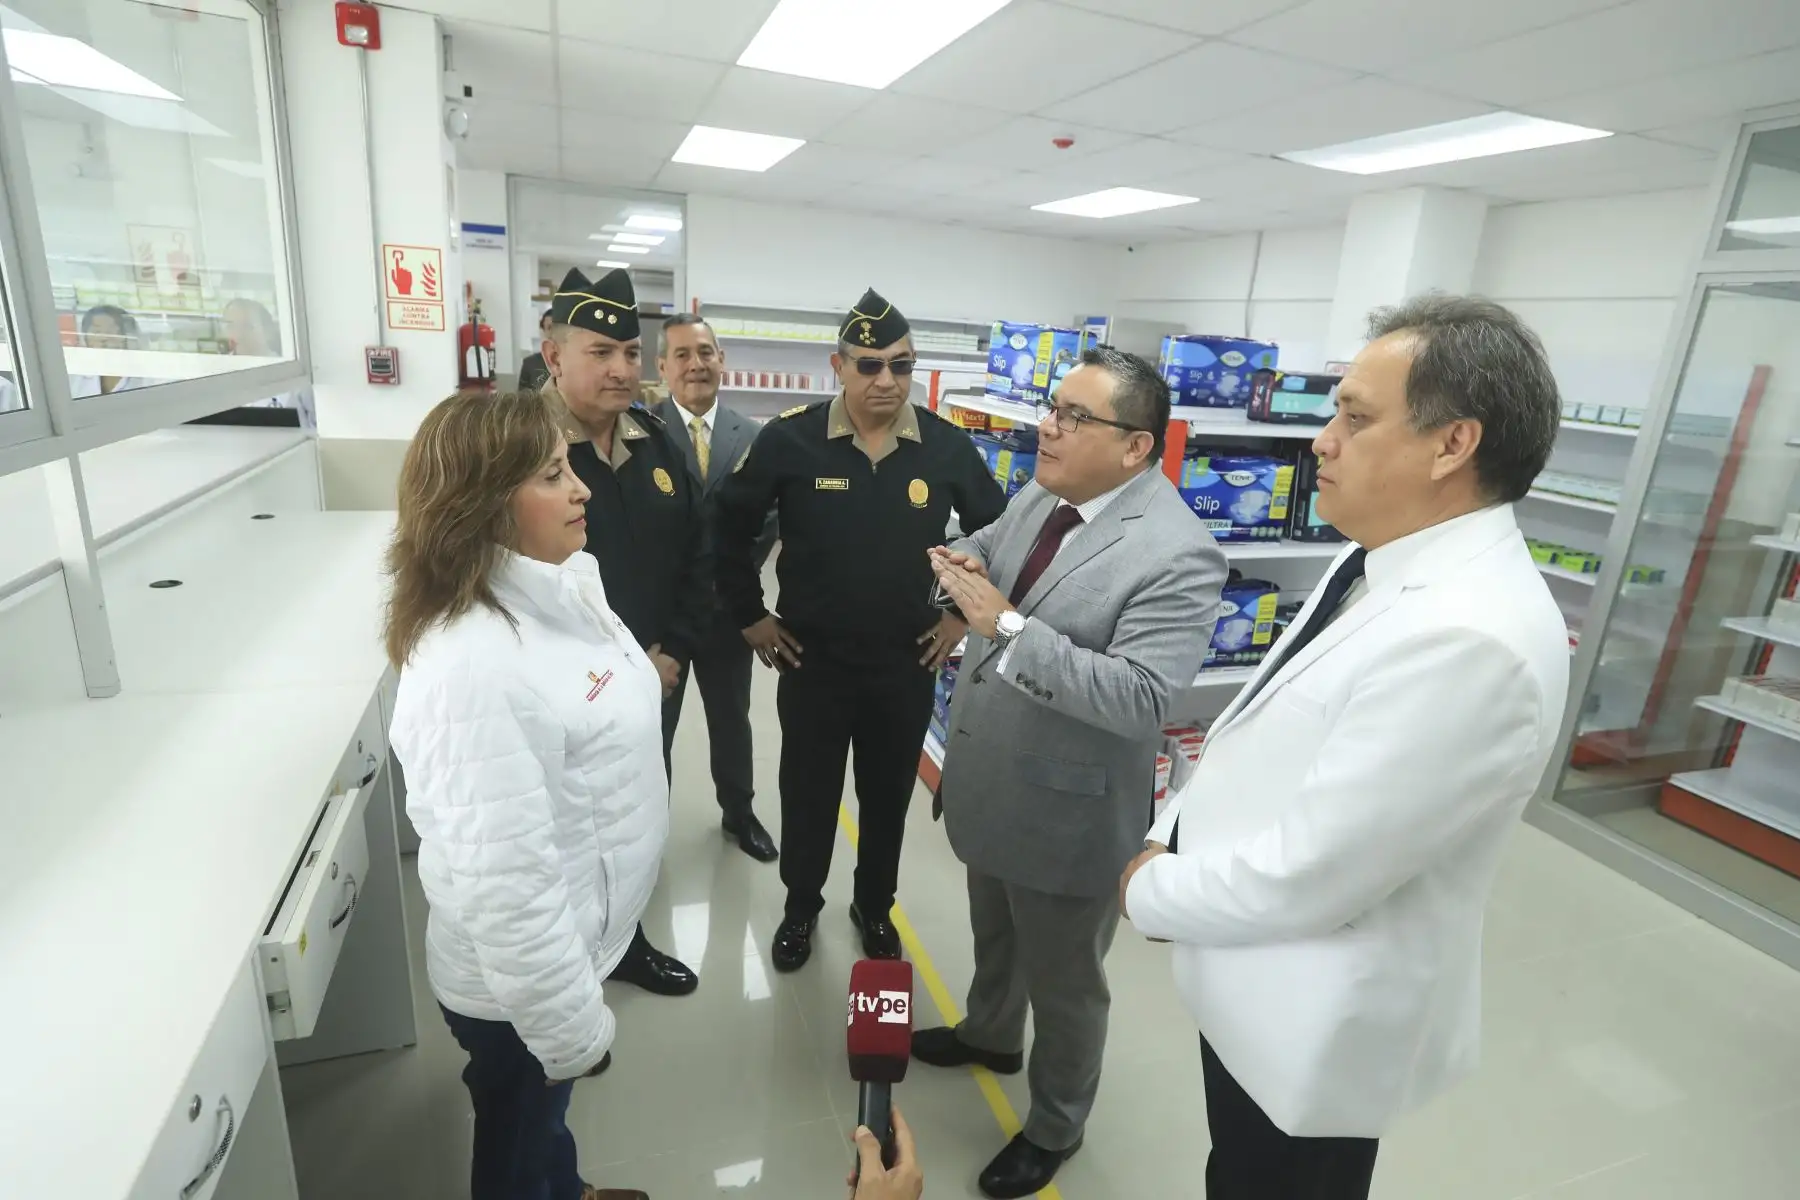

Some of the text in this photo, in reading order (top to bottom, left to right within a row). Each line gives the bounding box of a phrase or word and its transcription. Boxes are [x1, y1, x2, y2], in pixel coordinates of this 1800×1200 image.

[993, 354, 1006, 372] Slip
[1194, 495, 1220, 514] Slip
[857, 991, 906, 1018] tvpe
